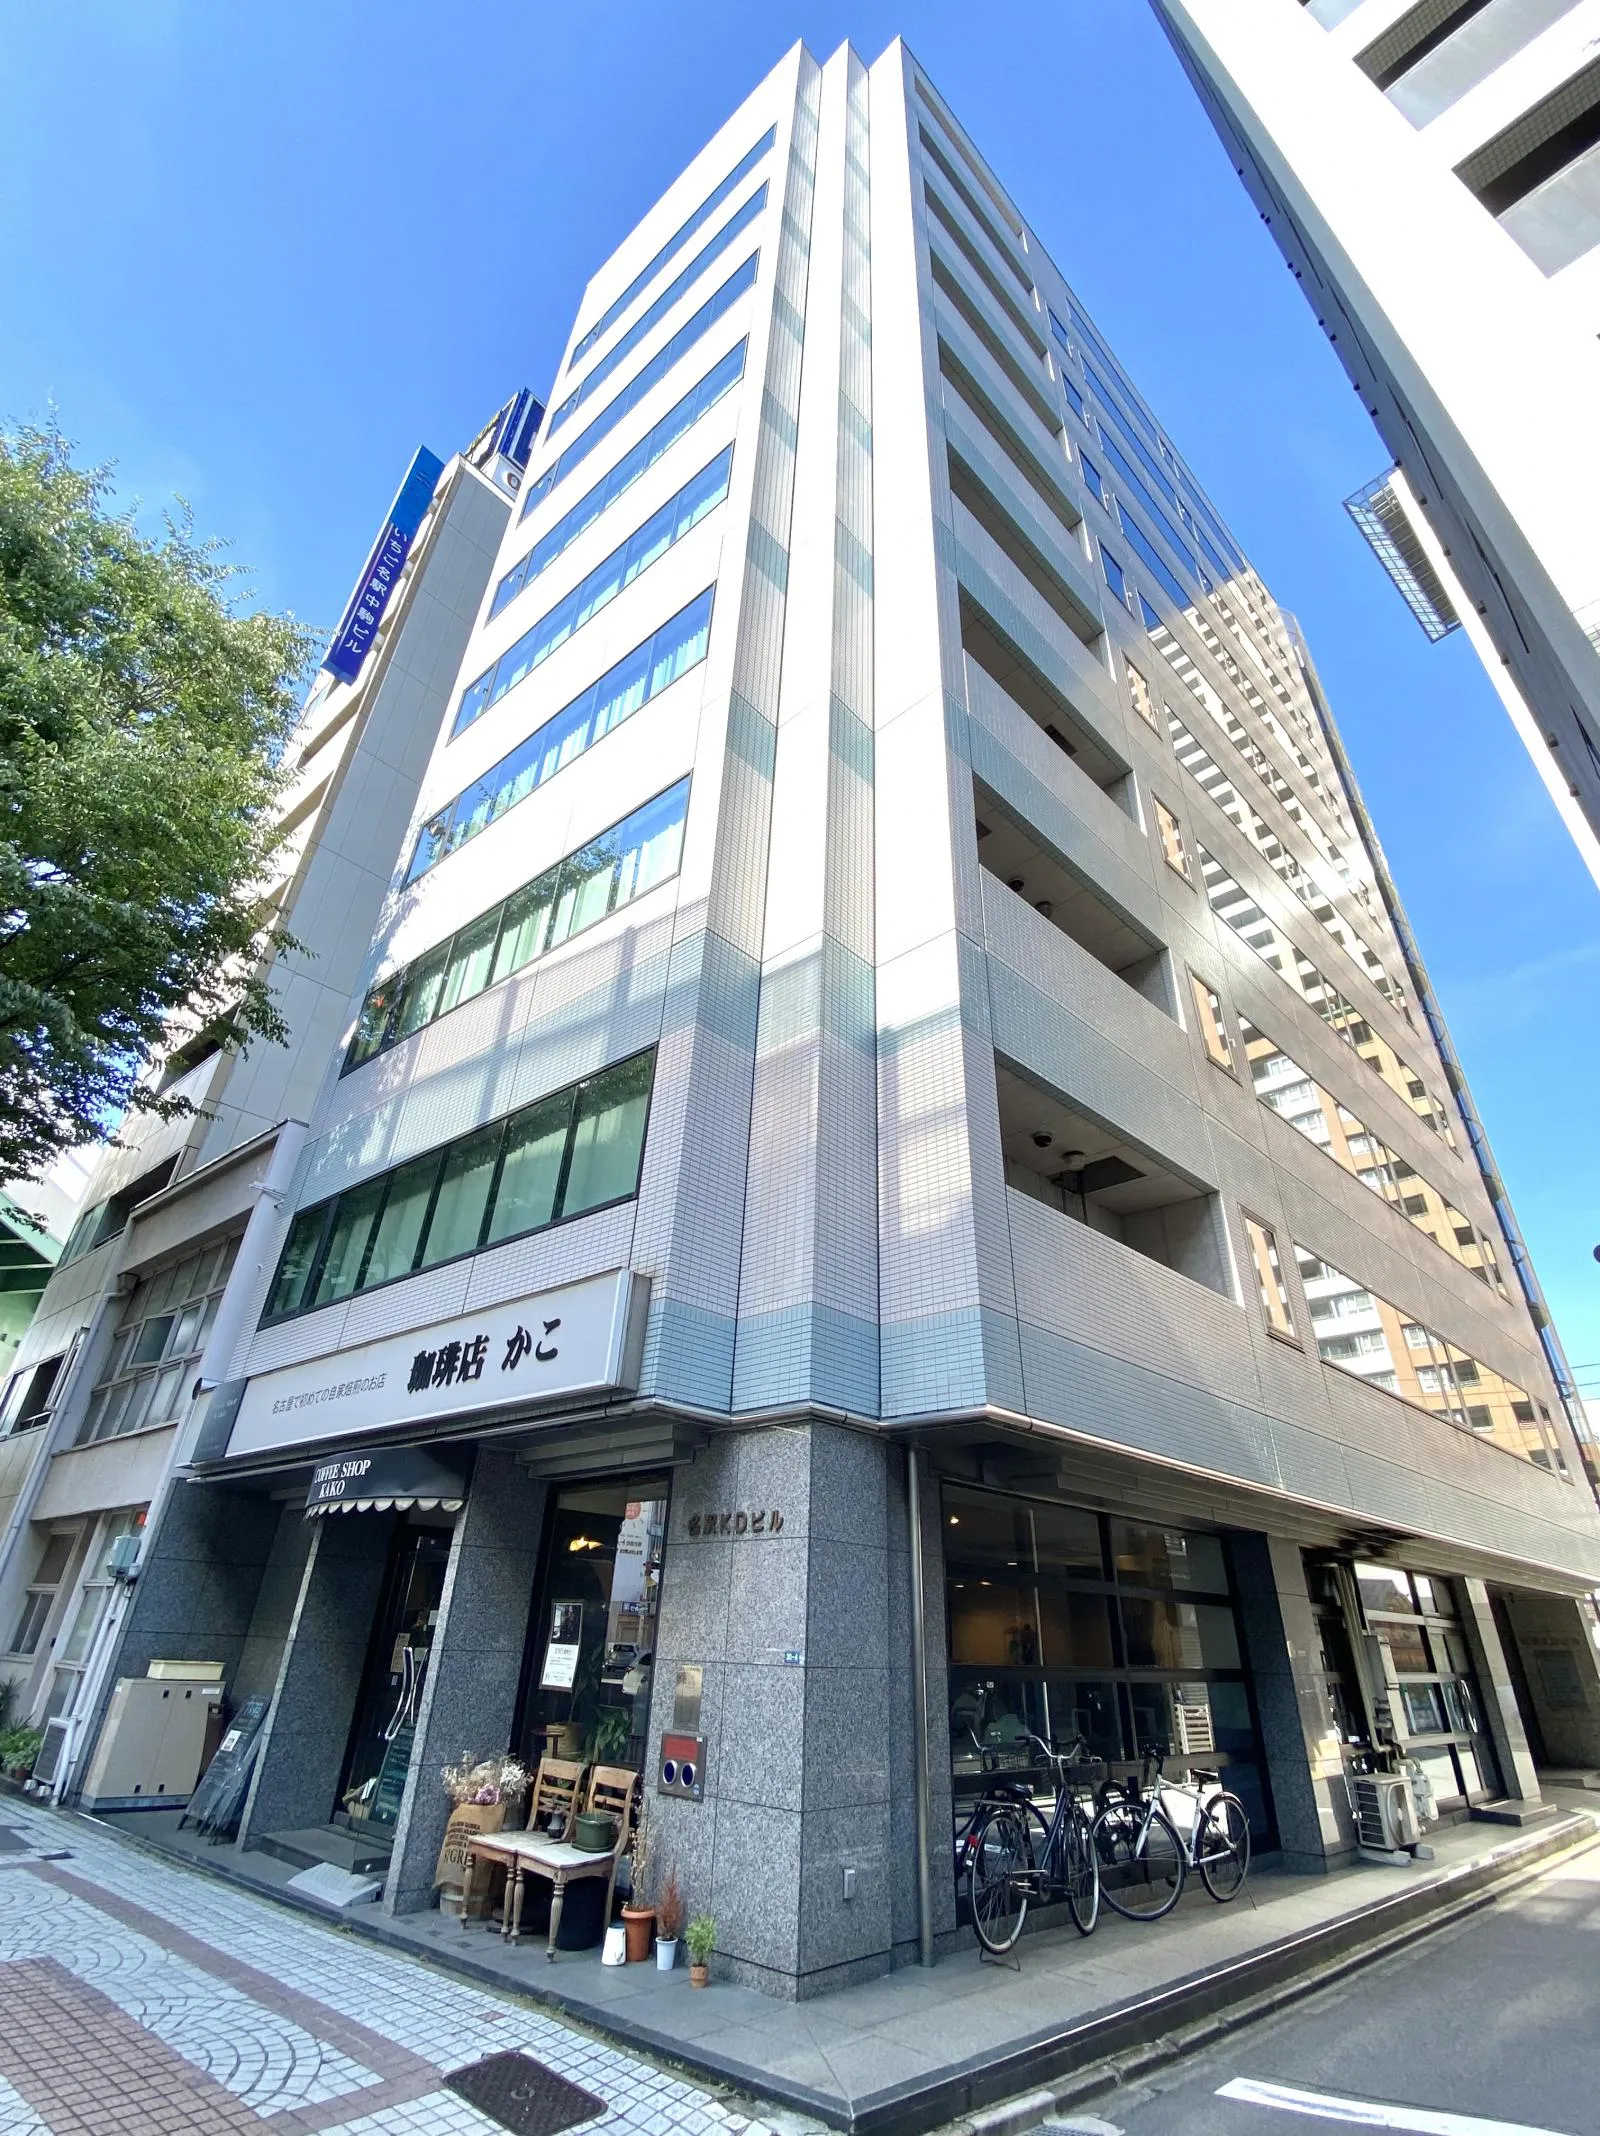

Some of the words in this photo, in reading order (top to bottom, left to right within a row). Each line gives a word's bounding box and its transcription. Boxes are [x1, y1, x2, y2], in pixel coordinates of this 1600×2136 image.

[345, 527, 407, 653] いちご名駅中駒ビル
[407, 1334, 490, 1394] 珈琲店
[501, 1318, 562, 1371] かこ
[272, 1372, 388, 1415] 名古屋で初めての自家焙煎のお店
[318, 1479, 346, 1499] KAKO
[341, 1459, 372, 1478] SHOP
